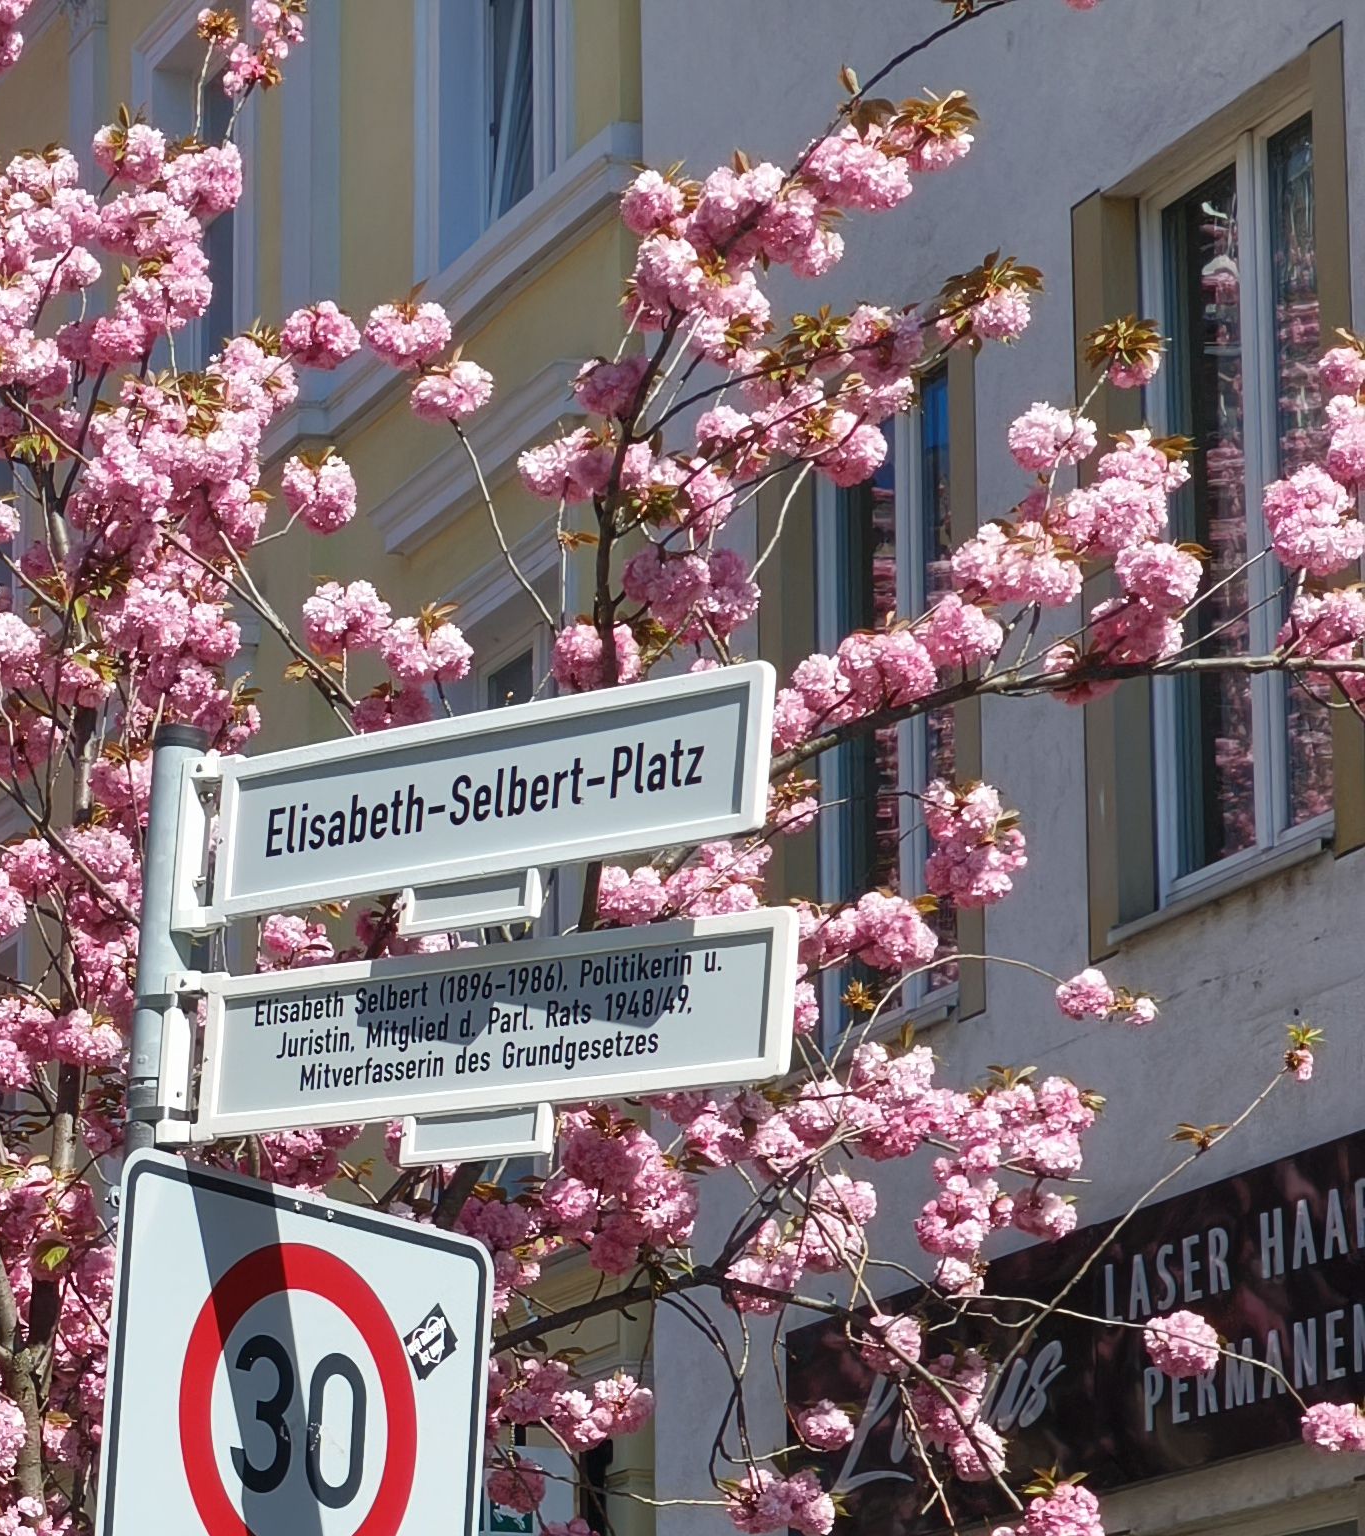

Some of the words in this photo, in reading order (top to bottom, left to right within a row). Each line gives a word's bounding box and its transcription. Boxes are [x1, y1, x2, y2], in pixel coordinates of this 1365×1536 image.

[266, 739, 705, 858] Elisabeth-Selbert-Platz
[255, 991, 343, 1026] Elisabeth
[355, 982, 429, 1015] Selbert
[580, 949, 692, 987] Politikerin
[704, 951, 722, 972] u.
[276, 1026, 355, 1059] Juristin,
[366, 1012, 448, 1052] Mitglied
[459, 1011, 476, 1037] d.
[488, 1004, 533, 1035] Parl.
[546, 1001, 591, 1028] Rats
[605, 984, 692, 1022] 1948/49,
[300, 1051, 444, 1091] Mitverfasserin
[456, 1046, 491, 1074] des
[502, 1031, 658, 1070] Grundgesetzes
[1104, 1227, 1231, 1327] LASER
[229, 1333, 368, 1510] 30
